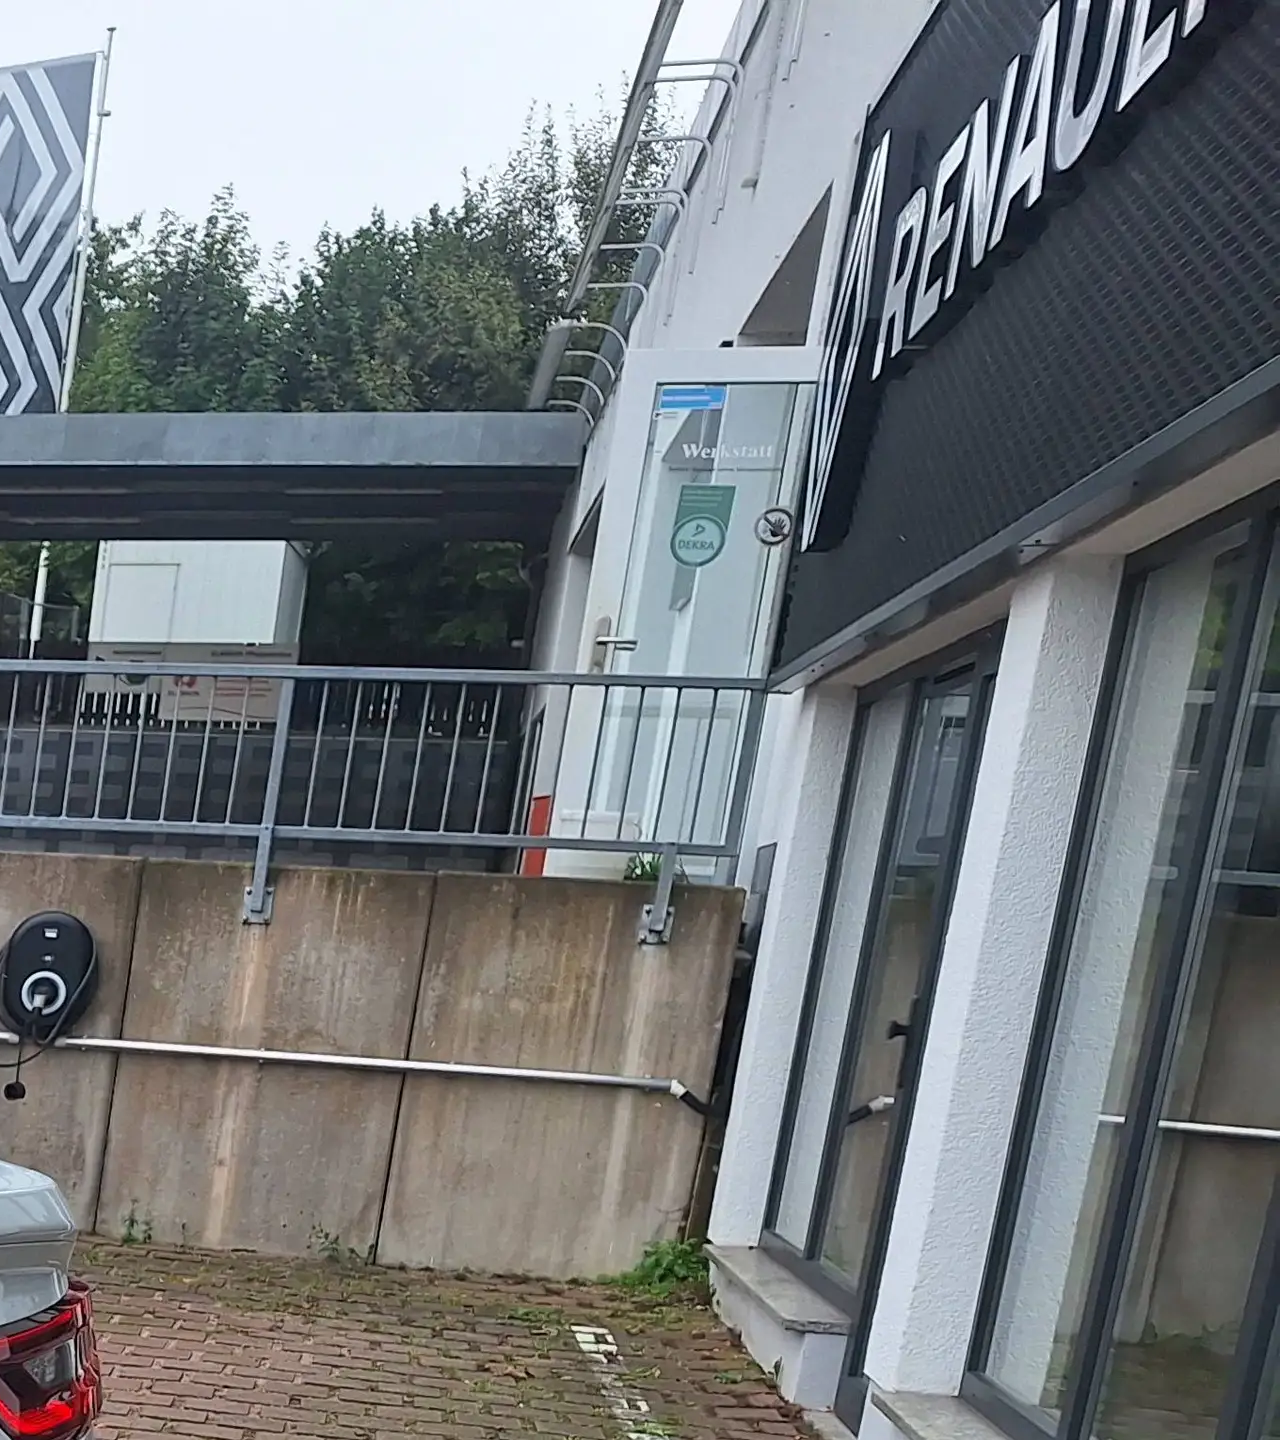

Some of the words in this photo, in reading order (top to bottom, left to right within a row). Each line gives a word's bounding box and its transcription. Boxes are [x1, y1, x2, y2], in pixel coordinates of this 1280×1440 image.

[872, 0, 1206, 381] RENAUL
[682, 443, 773, 459] Werkstatt
[677, 538, 716, 552] DEKRA
